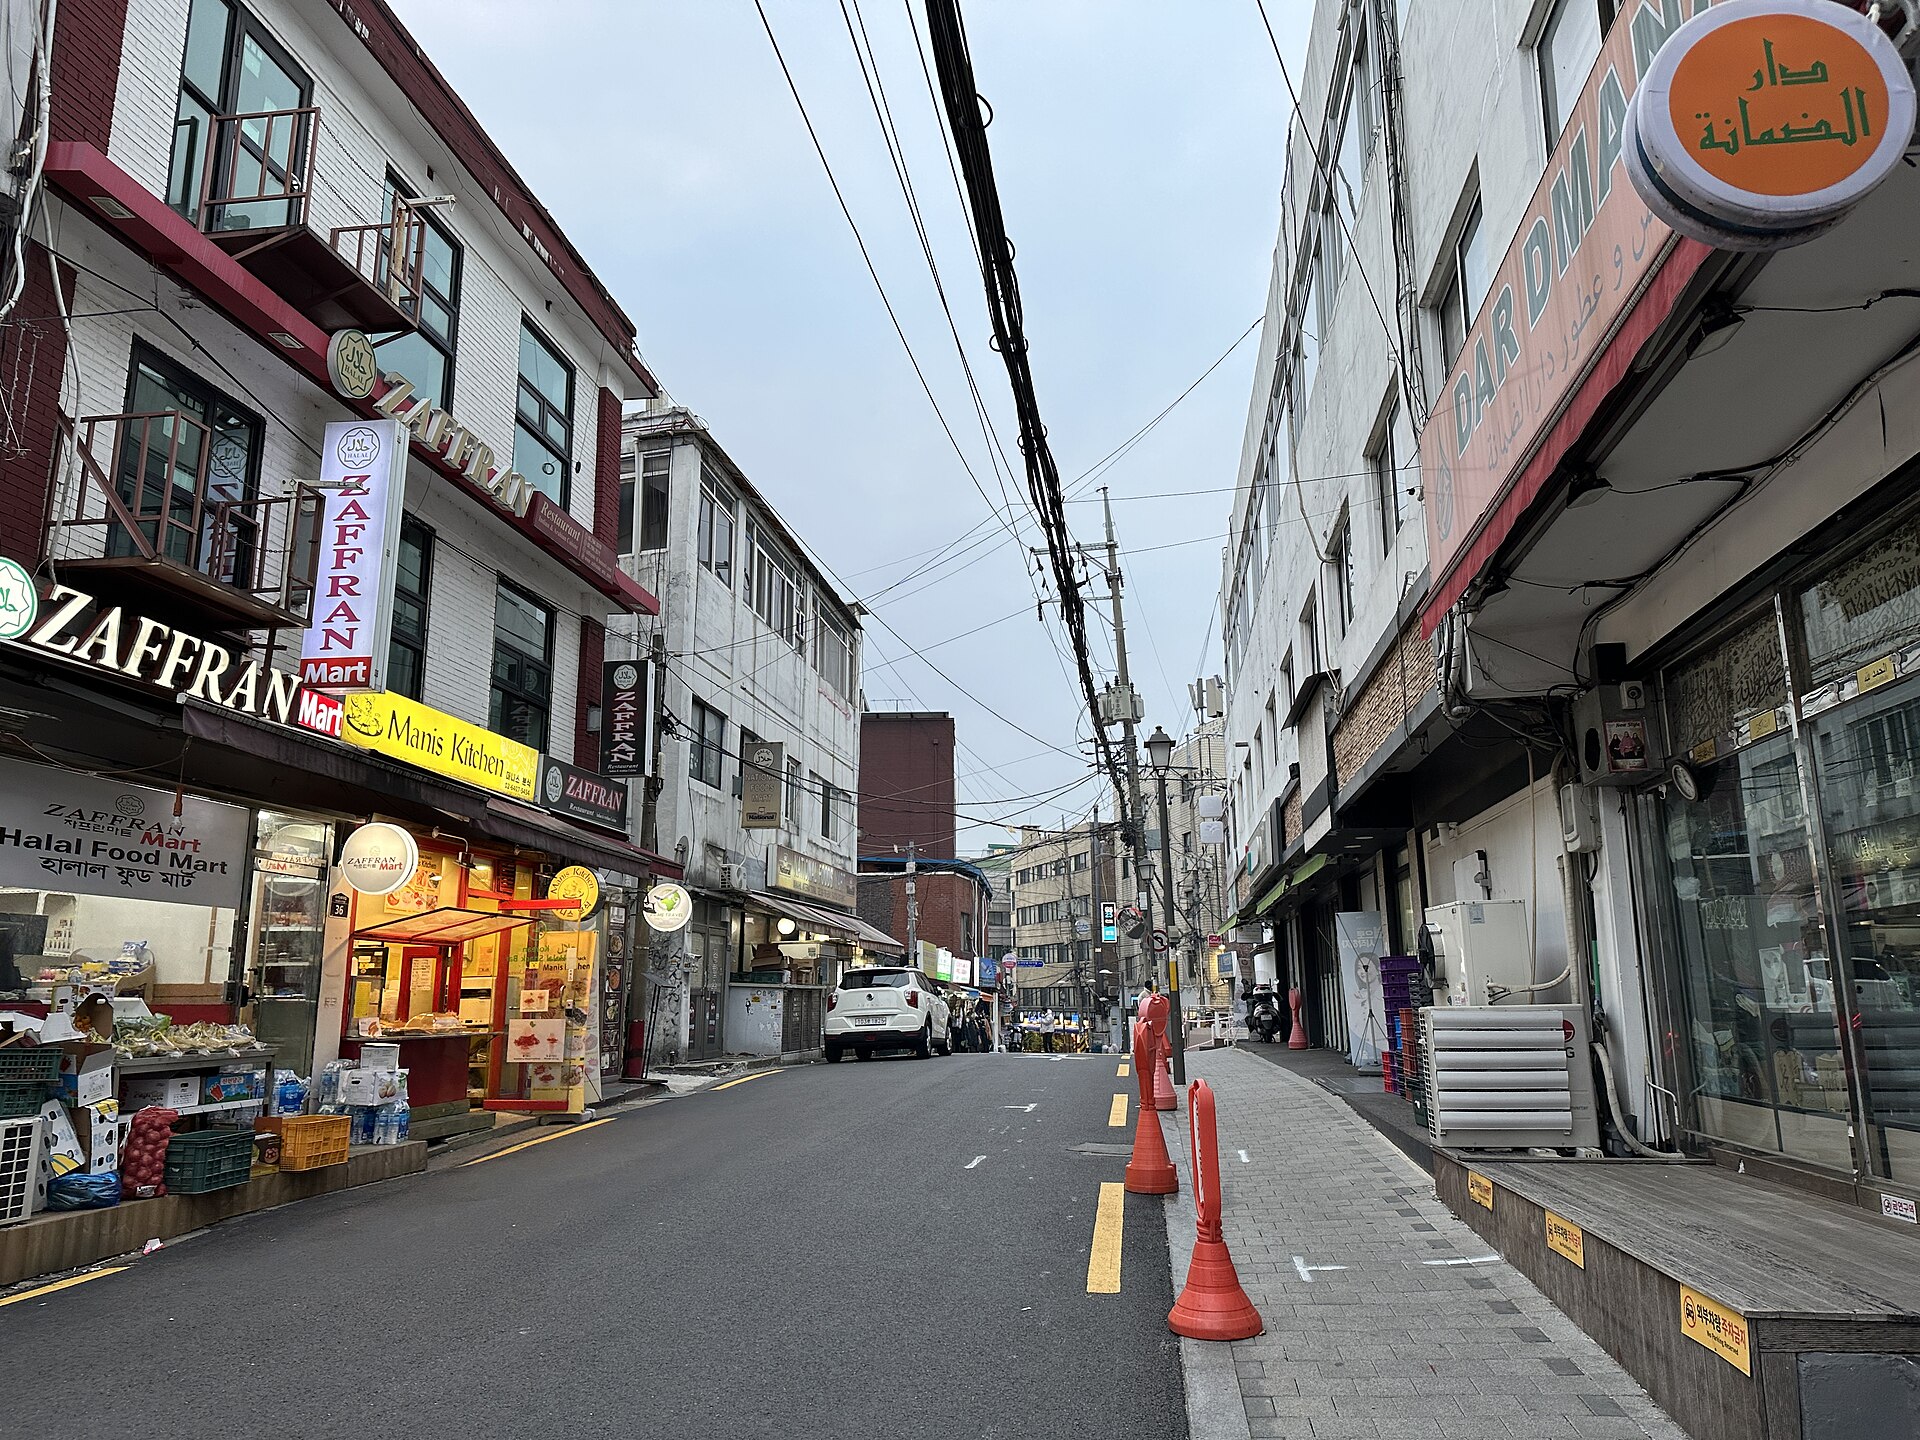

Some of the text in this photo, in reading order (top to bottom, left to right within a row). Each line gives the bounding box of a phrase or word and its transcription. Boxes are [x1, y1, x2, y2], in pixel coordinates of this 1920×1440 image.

[1746, 38, 1829, 92] دار
[1695, 87, 1871, 156] الضمانة
[1452, 281, 1521, 460] DAR
[372, 371, 536, 518] ZAFFRAN
[540, 500, 581, 542] Restaurant
[320, 474, 371, 650] ZAFFRAN
[28, 584, 304, 724] ZAFFRAN
[302, 660, 368, 685] Mart
[299, 690, 344, 735] Mart
[610, 691, 638, 762] ZAFFRAN
[387, 709, 505, 778] Manis Kitchen
[565, 776, 624, 813] ZAFFRAN
[43, 803, 186, 837] ZAFFRAN
[140, 831, 202, 853] Mart
[0, 826, 228, 875] Halal Food Mart
[347, 856, 397, 865] ZAFFRAN
[379, 862, 404, 871] Mart
[334, 904, 344, 915] 36
[1696, 1303, 1747, 1351] 외부차량 주차금지
